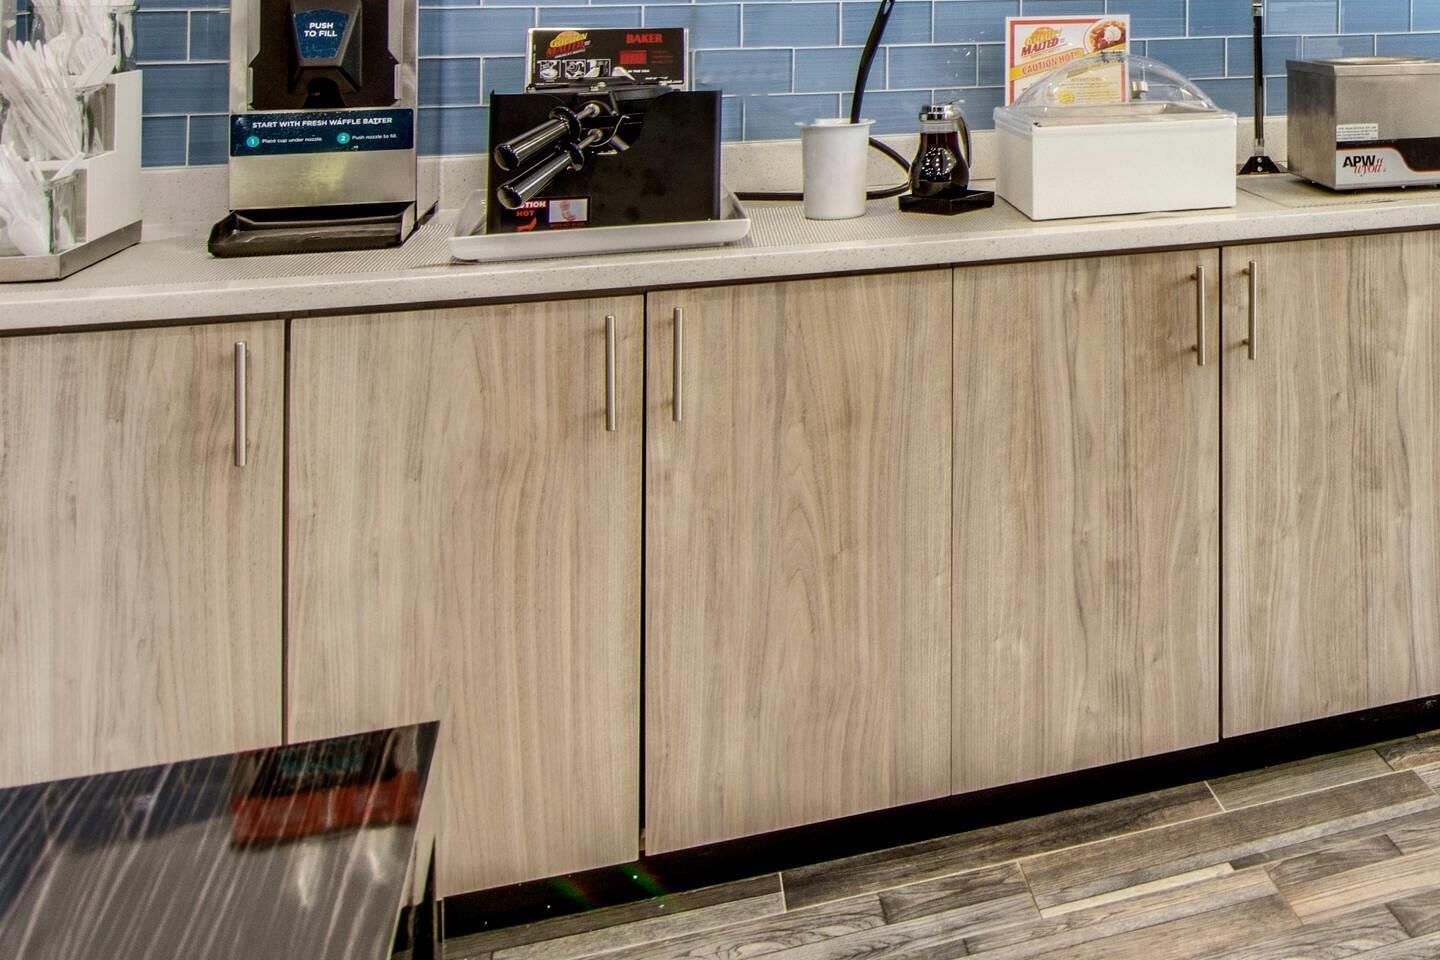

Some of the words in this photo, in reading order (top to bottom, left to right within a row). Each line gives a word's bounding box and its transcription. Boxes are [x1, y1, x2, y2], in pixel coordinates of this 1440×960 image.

[625, 34, 663, 44] BAKER
[1021, 37, 1060, 57] MALTED
[1022, 57, 1058, 76] CAUTION
[252, 121, 278, 129] START
[279, 120, 301, 128] WITH
[301, 119, 328, 127] FRESH
[329, 118, 363, 126] WAFFLE
[363, 117, 393, 125] BATTER
[1343, 155, 1376, 168] APW
[521, 200, 547, 209] TION
